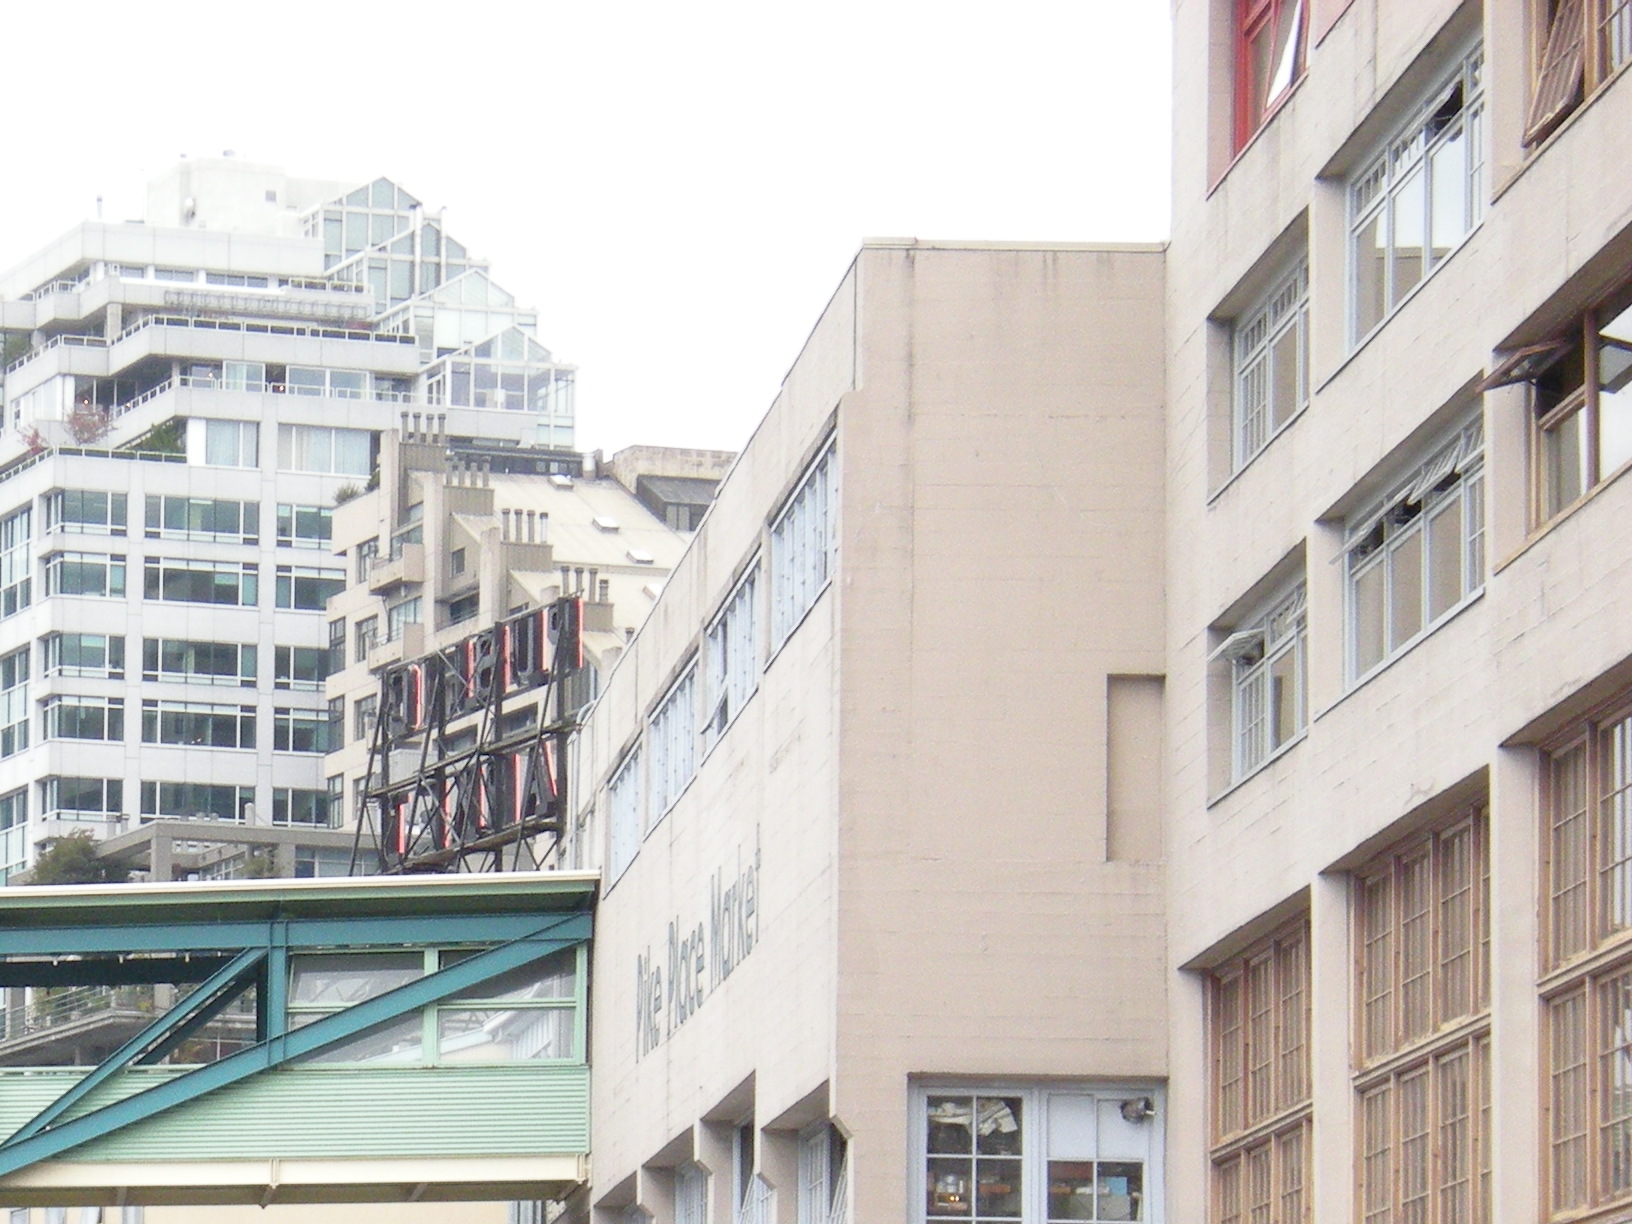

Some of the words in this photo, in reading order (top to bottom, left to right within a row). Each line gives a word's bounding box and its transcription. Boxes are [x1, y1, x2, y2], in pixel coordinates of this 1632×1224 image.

[635, 945, 662, 1064] Pike
[667, 914, 705, 1041] Place
[710, 822, 761, 995] Market
